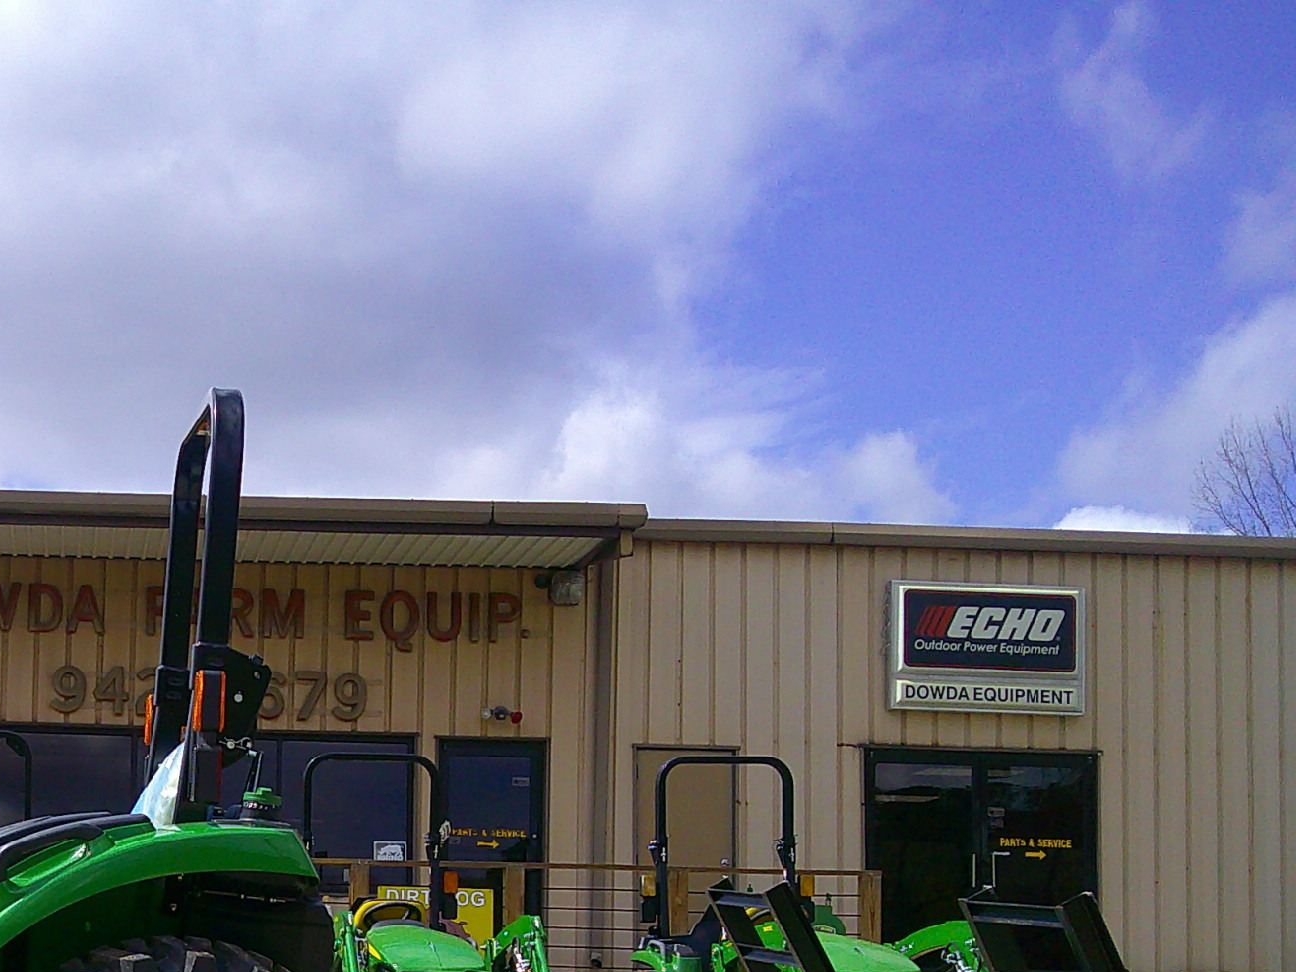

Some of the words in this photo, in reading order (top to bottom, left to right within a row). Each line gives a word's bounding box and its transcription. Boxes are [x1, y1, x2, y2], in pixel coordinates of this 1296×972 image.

[145, 585, 306, 639] FRM
[344, 589, 531, 653] EQUIP.
[947, 605, 1066, 642] ECHO
[914, 638, 962, 651] Outdoor
[964, 641, 998, 653] Power
[999, 642, 1060, 657] Equipment
[905, 685, 971, 701] DOWDA
[972, 687, 1074, 705] EQUIPMENT
[999, 837, 1026, 847] PARTS
[1029, 838, 1035, 848] &
[1037, 839, 1073, 849] SERVICE
[455, 890, 486, 907] OG
